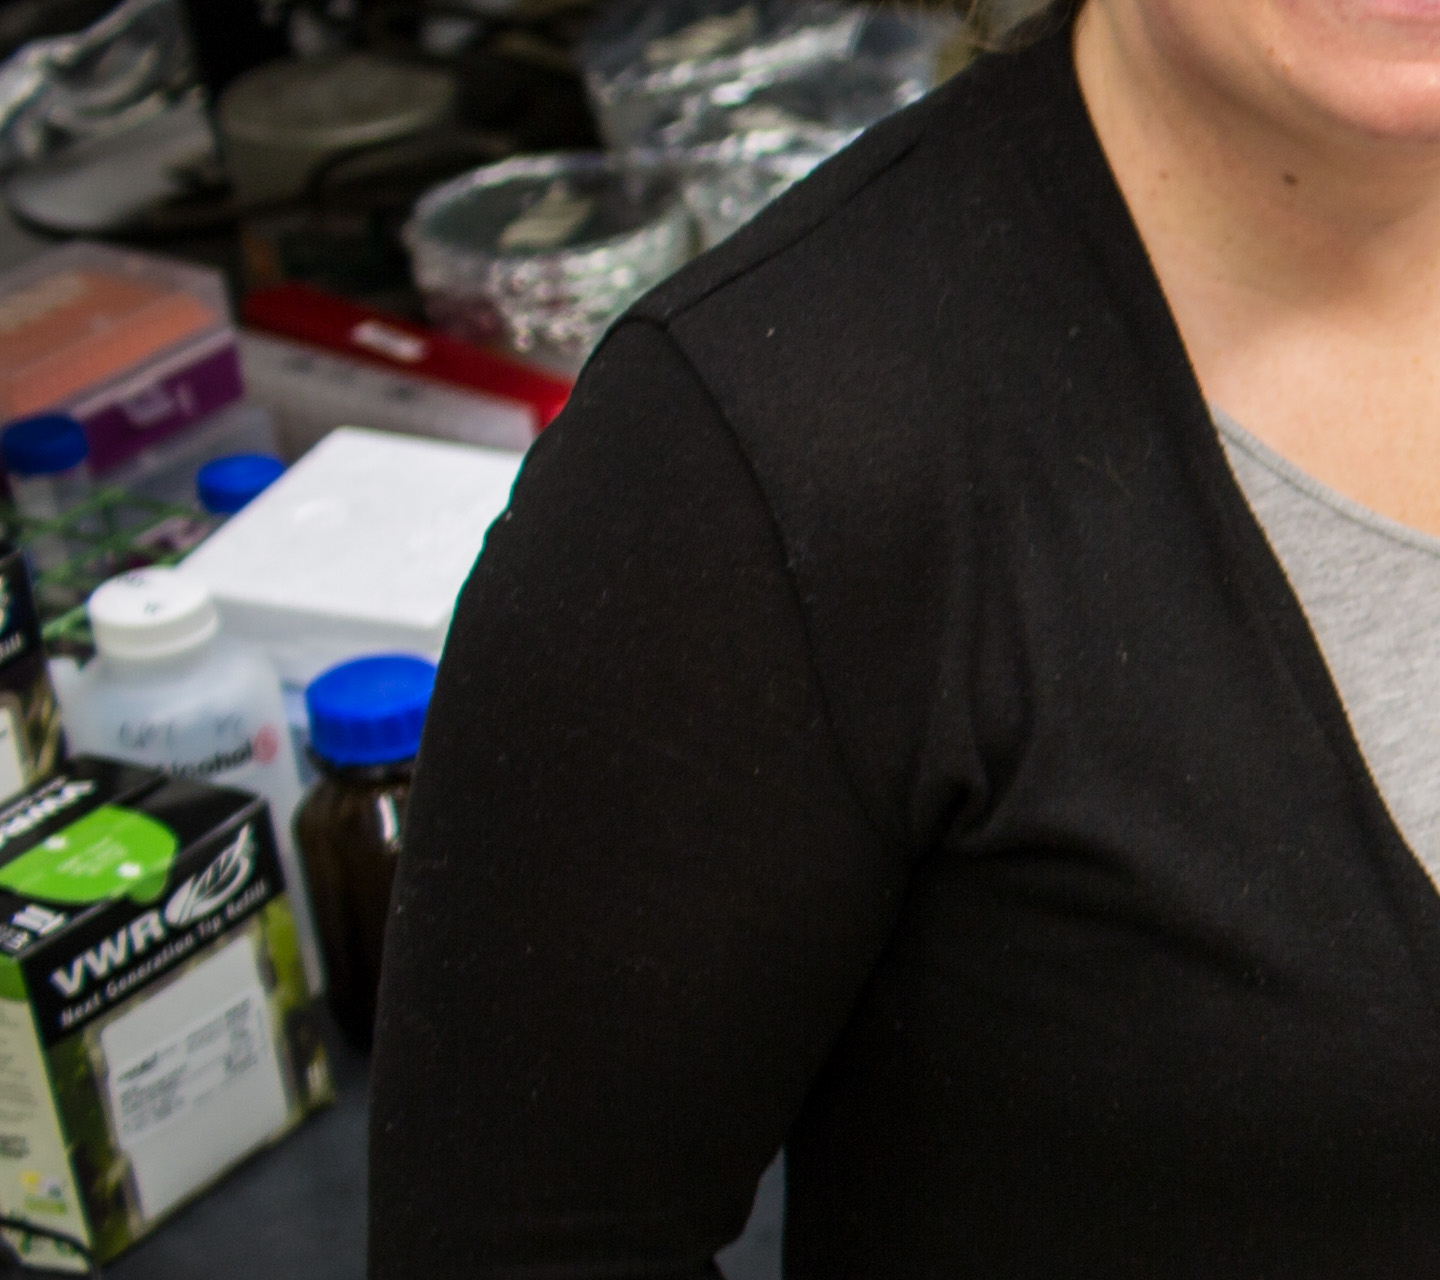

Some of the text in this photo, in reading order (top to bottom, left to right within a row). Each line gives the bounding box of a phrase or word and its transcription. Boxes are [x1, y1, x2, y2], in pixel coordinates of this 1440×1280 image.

[49, 908, 167, 999] VWR
[59, 877, 268, 1029] Next Generation Tip Refill
